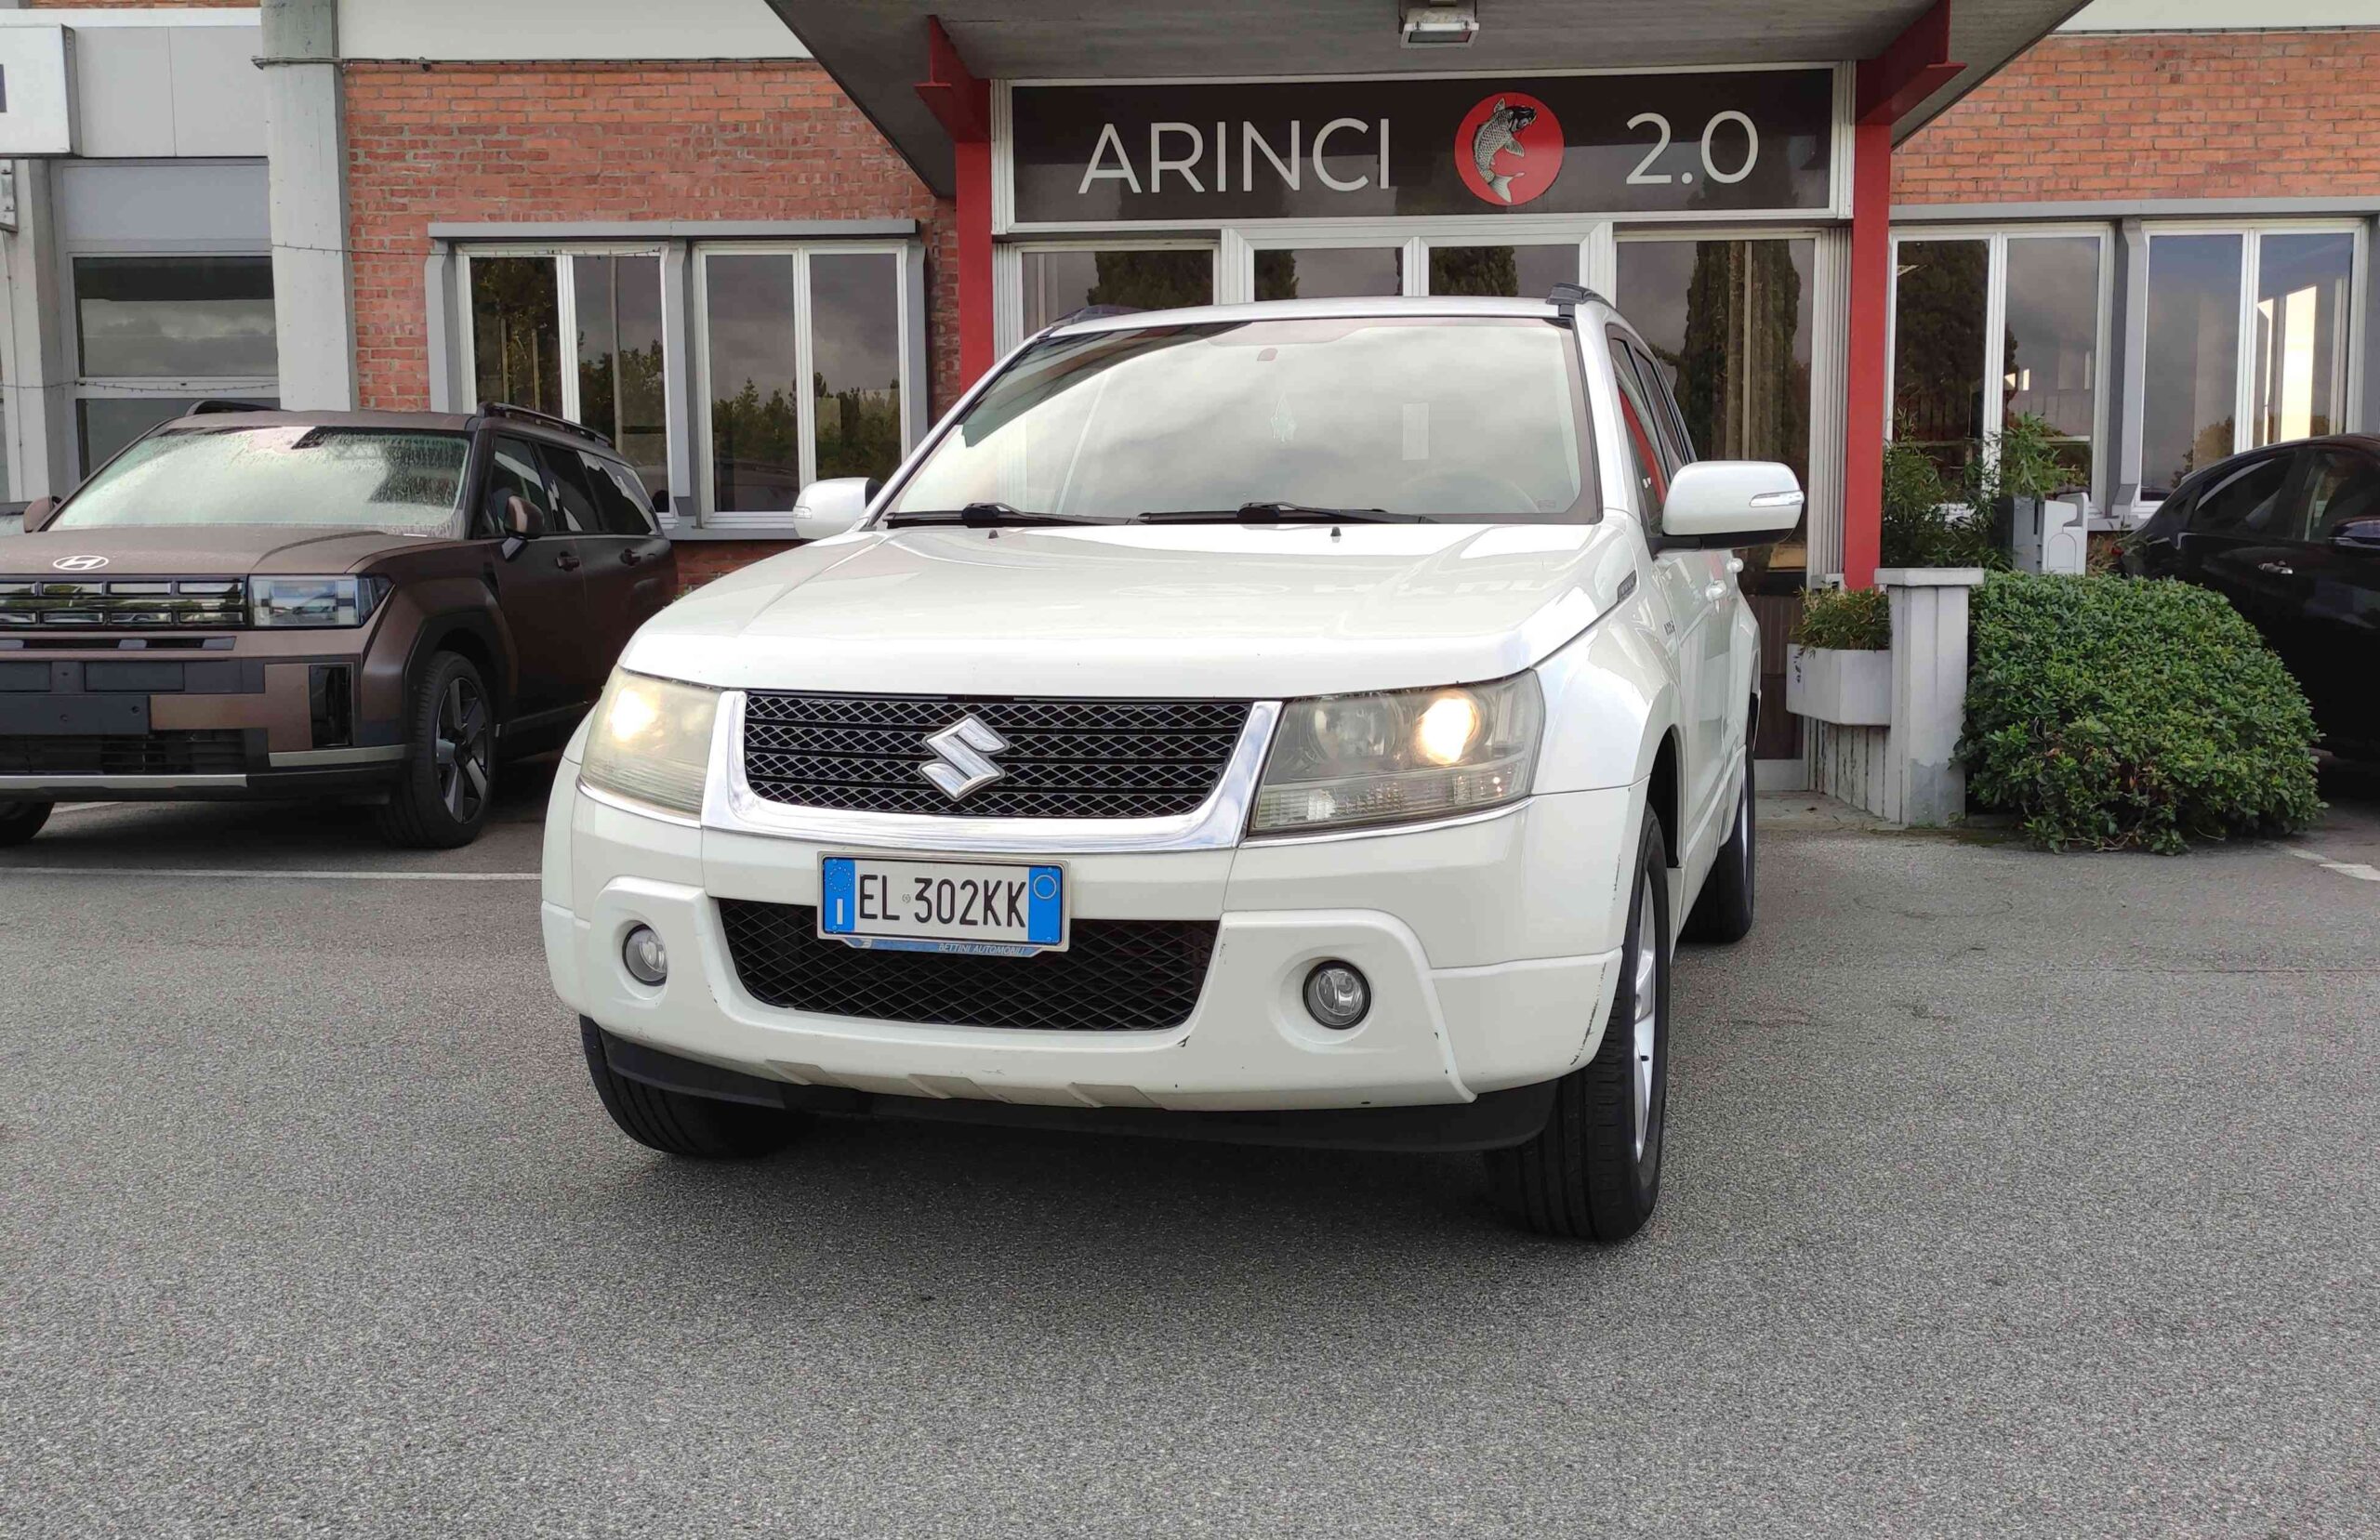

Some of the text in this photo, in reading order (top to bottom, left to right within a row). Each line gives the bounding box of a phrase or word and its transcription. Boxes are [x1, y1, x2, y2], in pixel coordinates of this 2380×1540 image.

[1078, 111, 1759, 194] ARINCI 2.0
[859, 874, 1026, 928] EL 302KK
[938, 943, 971, 953] BETTINI
